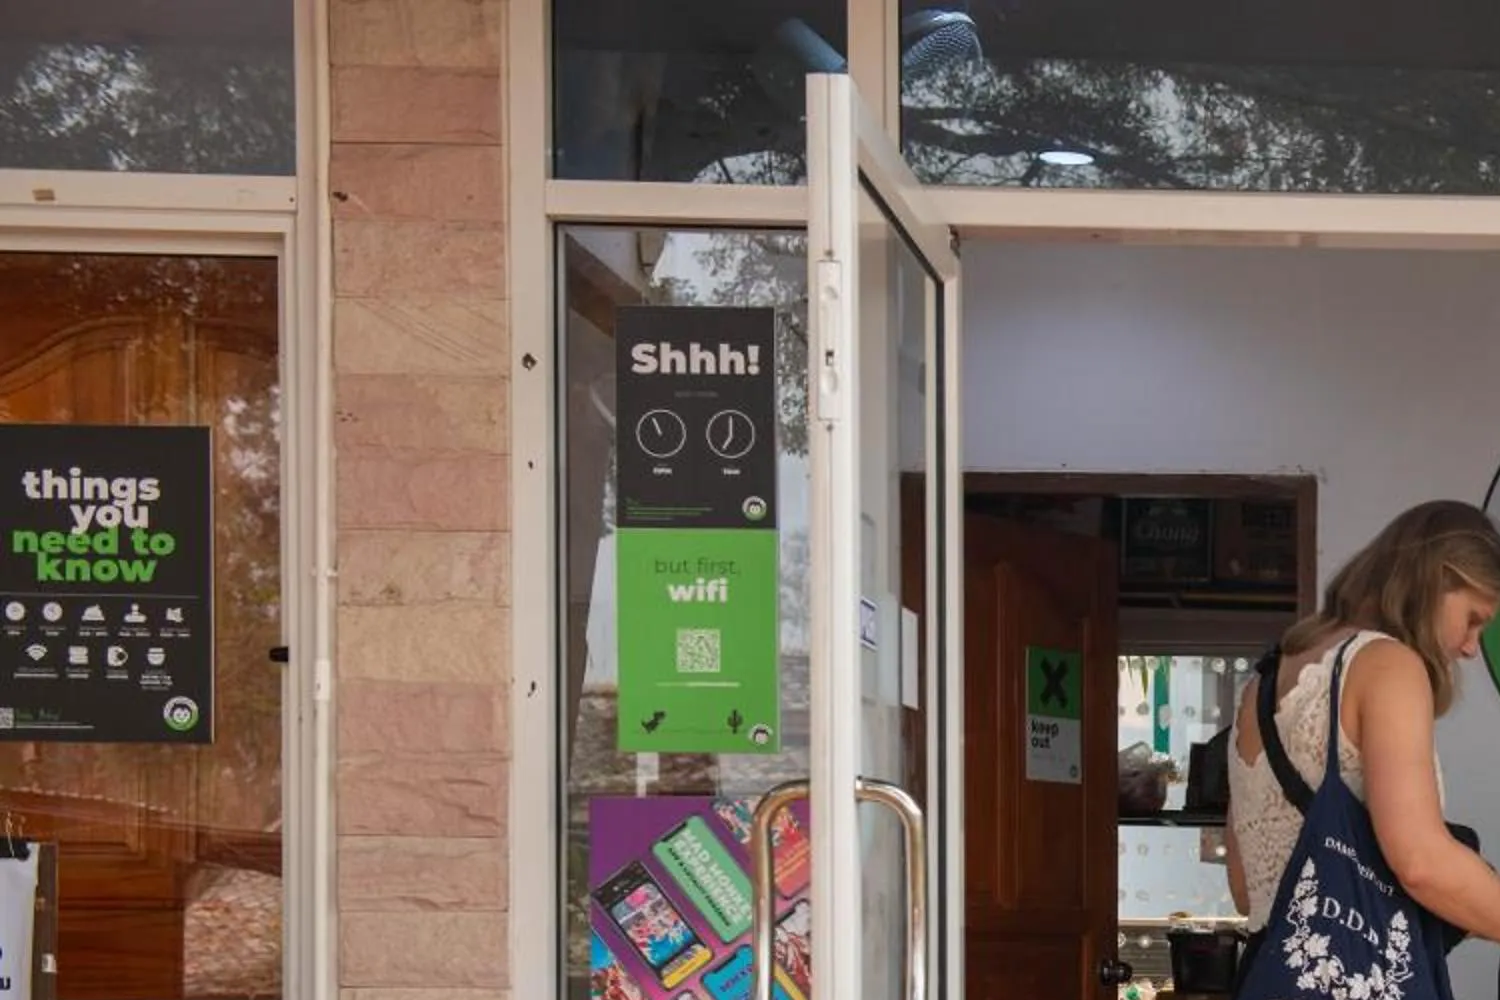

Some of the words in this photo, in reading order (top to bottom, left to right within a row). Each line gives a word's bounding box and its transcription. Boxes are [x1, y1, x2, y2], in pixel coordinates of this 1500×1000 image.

[630, 341, 761, 376] Shhh!
[21, 466, 161, 508] things
[70, 503, 149, 535] you
[12, 527, 119, 554] need
[130, 529, 176, 556] to
[37, 551, 157, 582] know
[654, 556, 690, 575] but
[667, 577, 729, 603] wifi
[709, 862, 753, 920] MONKE
